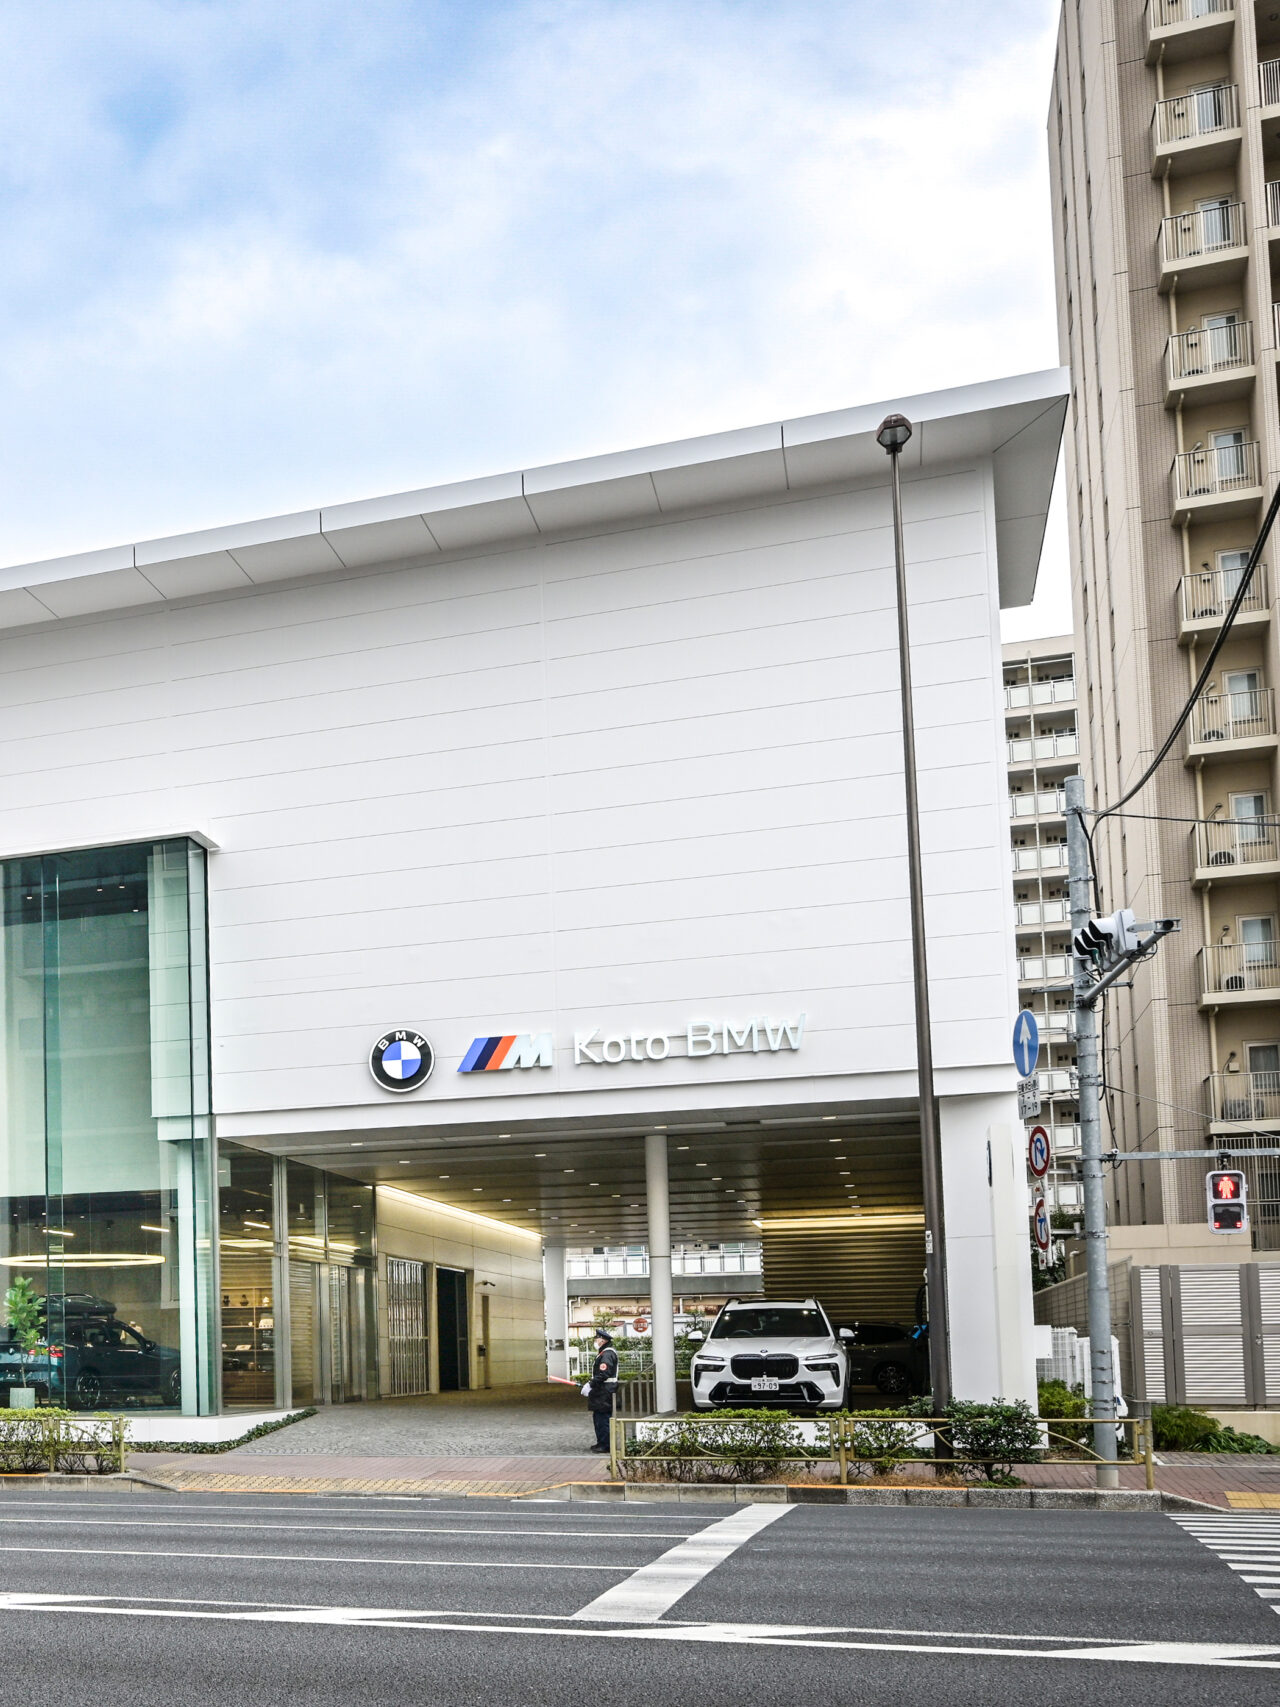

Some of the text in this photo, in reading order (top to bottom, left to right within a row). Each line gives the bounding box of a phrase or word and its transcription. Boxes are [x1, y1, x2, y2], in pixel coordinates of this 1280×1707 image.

[378, 1031, 426, 1051] BMW
[574, 1013, 807, 1065] Koto BMW
